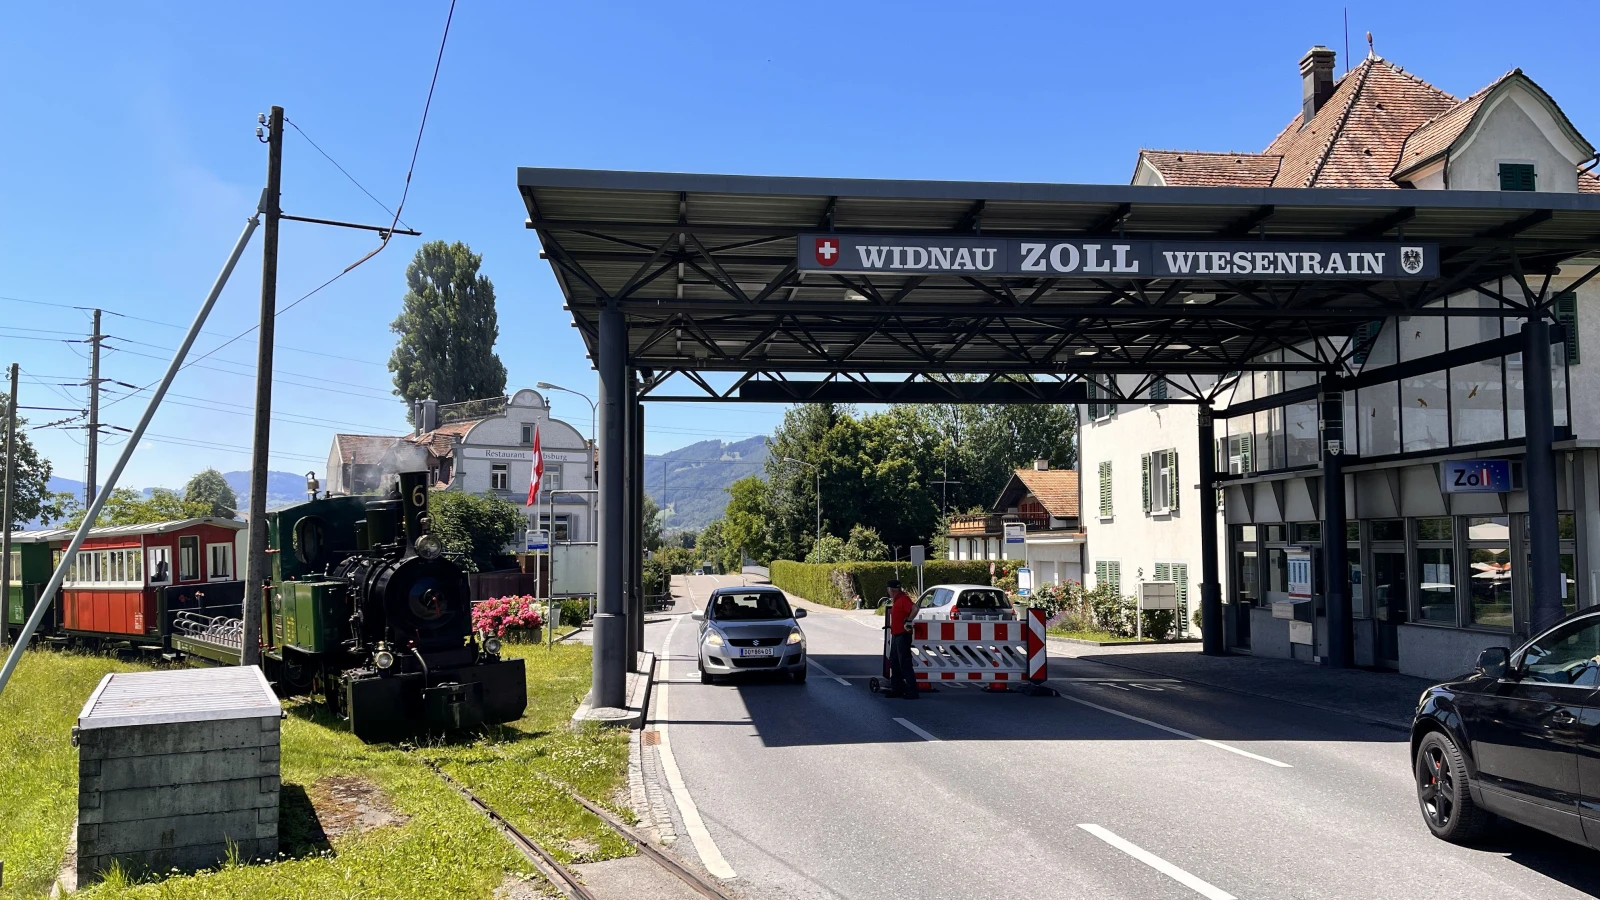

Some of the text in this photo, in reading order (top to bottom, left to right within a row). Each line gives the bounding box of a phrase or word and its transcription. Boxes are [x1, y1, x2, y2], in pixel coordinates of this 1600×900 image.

[855, 243, 1386, 274] WIDNAU ZOLL WIESENRAIN
[485, 449, 568, 461] Restaurant bsburg
[1453, 468, 1491, 487] Zoll
[412, 484, 425, 507] 6
